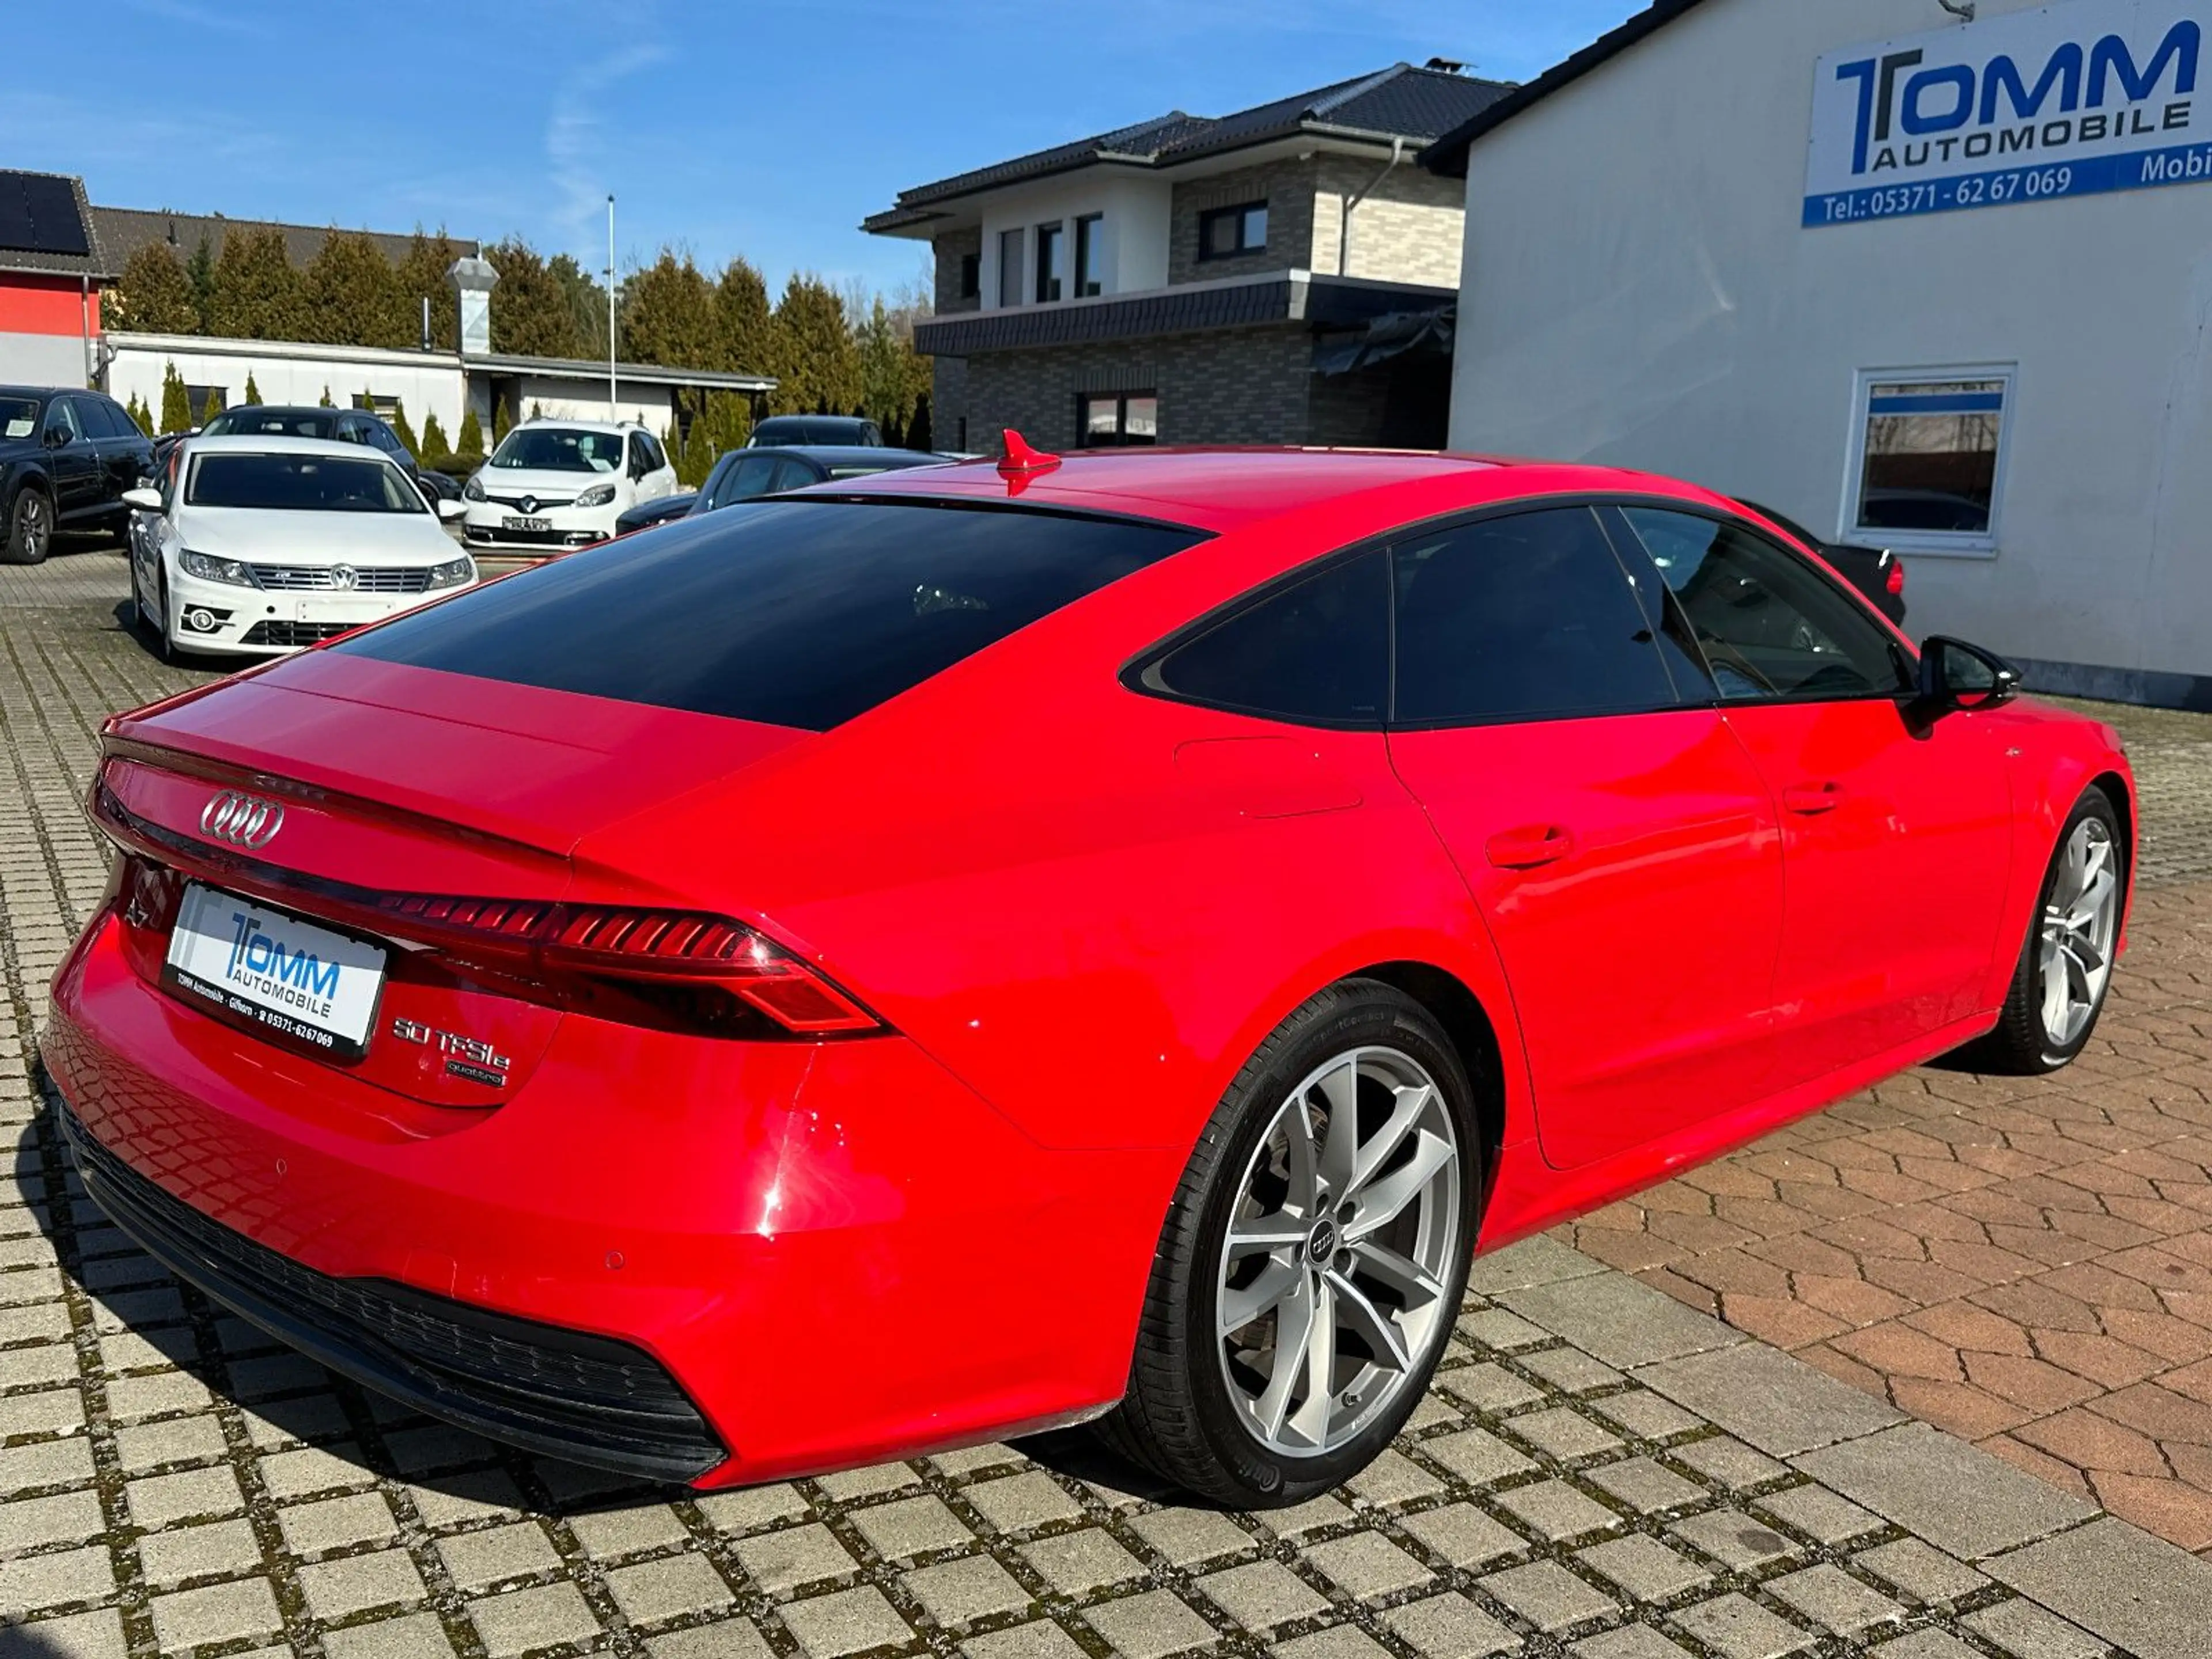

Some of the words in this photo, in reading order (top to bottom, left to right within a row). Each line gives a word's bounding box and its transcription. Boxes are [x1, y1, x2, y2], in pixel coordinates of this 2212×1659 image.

[1872, 101, 2191, 171] AUTOMOBILE
[1824, 195, 1866, 220] Tel.:
[1871, 185, 1936, 214] 05371
[1957, 178, 1984, 203] 62
[1991, 174, 2020, 199] 67
[2026, 167, 2072, 196] 069
[232, 969, 331, 1018] AUTOMOBILE
[393, 1017, 430, 1045] 50
[448, 1061, 501, 1084] quattro
